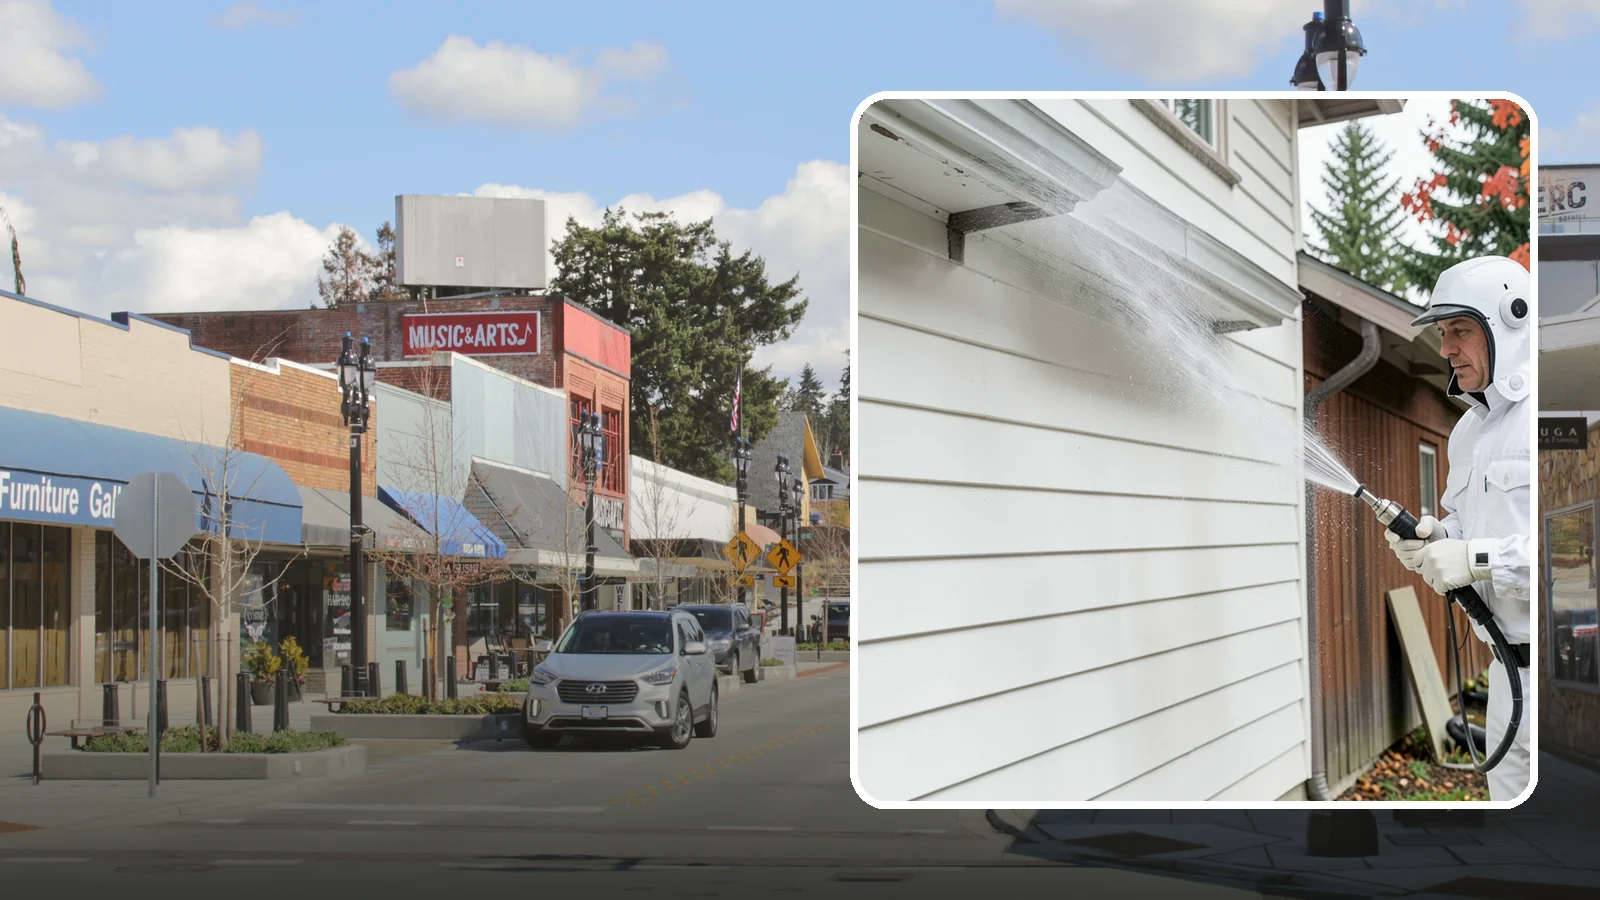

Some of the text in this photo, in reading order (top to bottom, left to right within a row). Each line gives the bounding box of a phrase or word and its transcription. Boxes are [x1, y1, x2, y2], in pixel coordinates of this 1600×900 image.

[408, 323, 520, 349] MUSIC&ARTS
[0, 471, 122, 519] Furniture Gal
